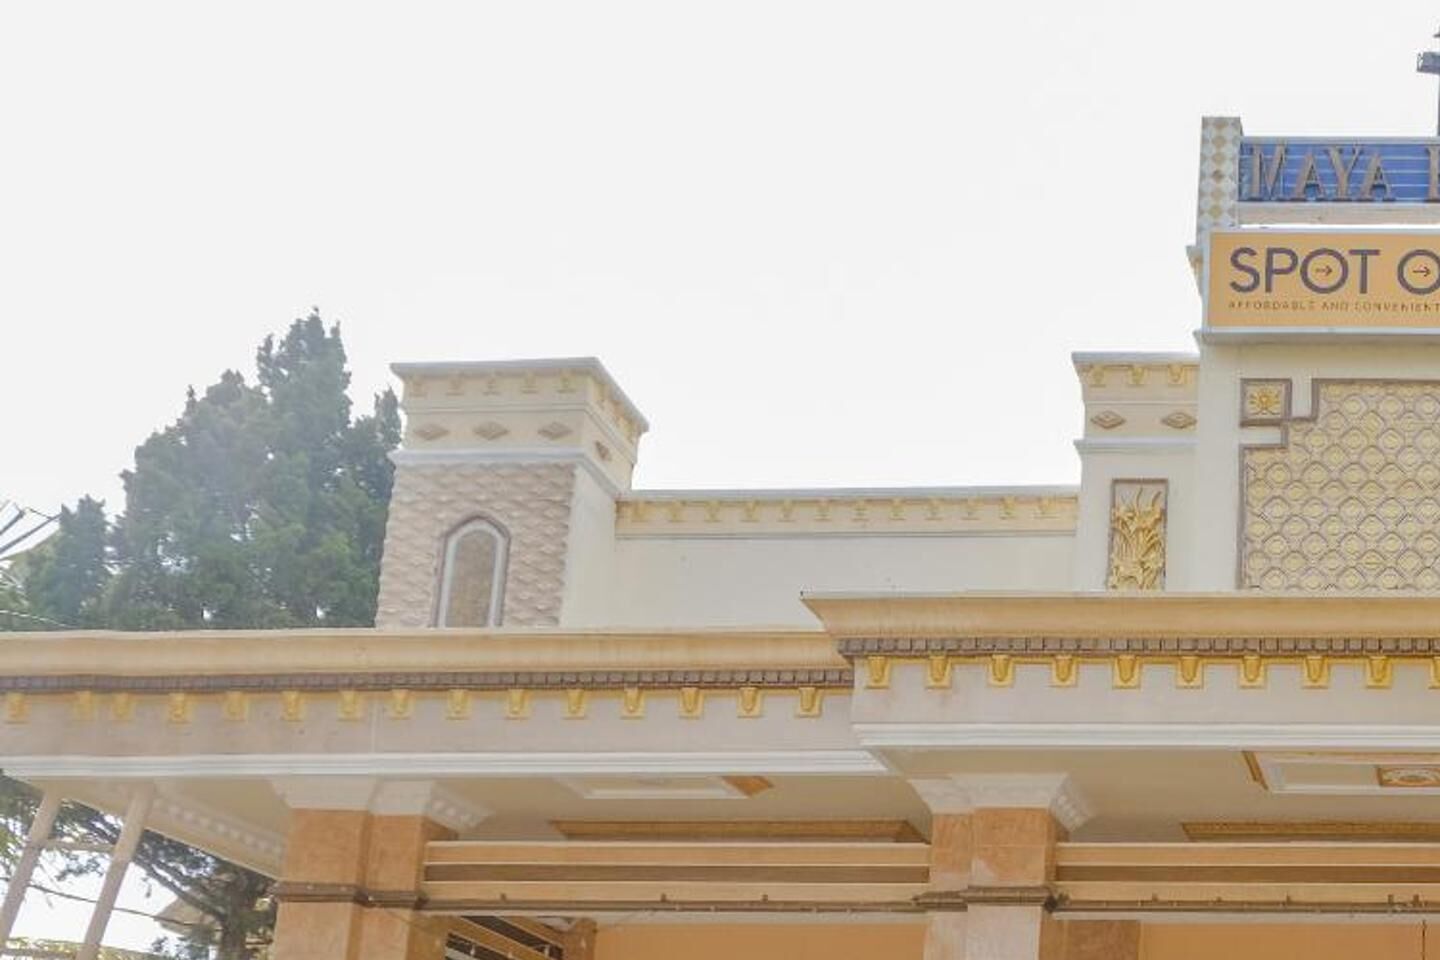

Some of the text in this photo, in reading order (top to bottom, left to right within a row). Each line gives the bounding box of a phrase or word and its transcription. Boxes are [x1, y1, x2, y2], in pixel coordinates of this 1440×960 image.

[1248, 143, 1396, 203] MAYA
[1229, 247, 1380, 294] SPOT
[1229, 300, 1315, 311] AFFORDABLE
[1321, 301, 1349, 312] AND
[1354, 301, 1440, 313] CONVENIENT
